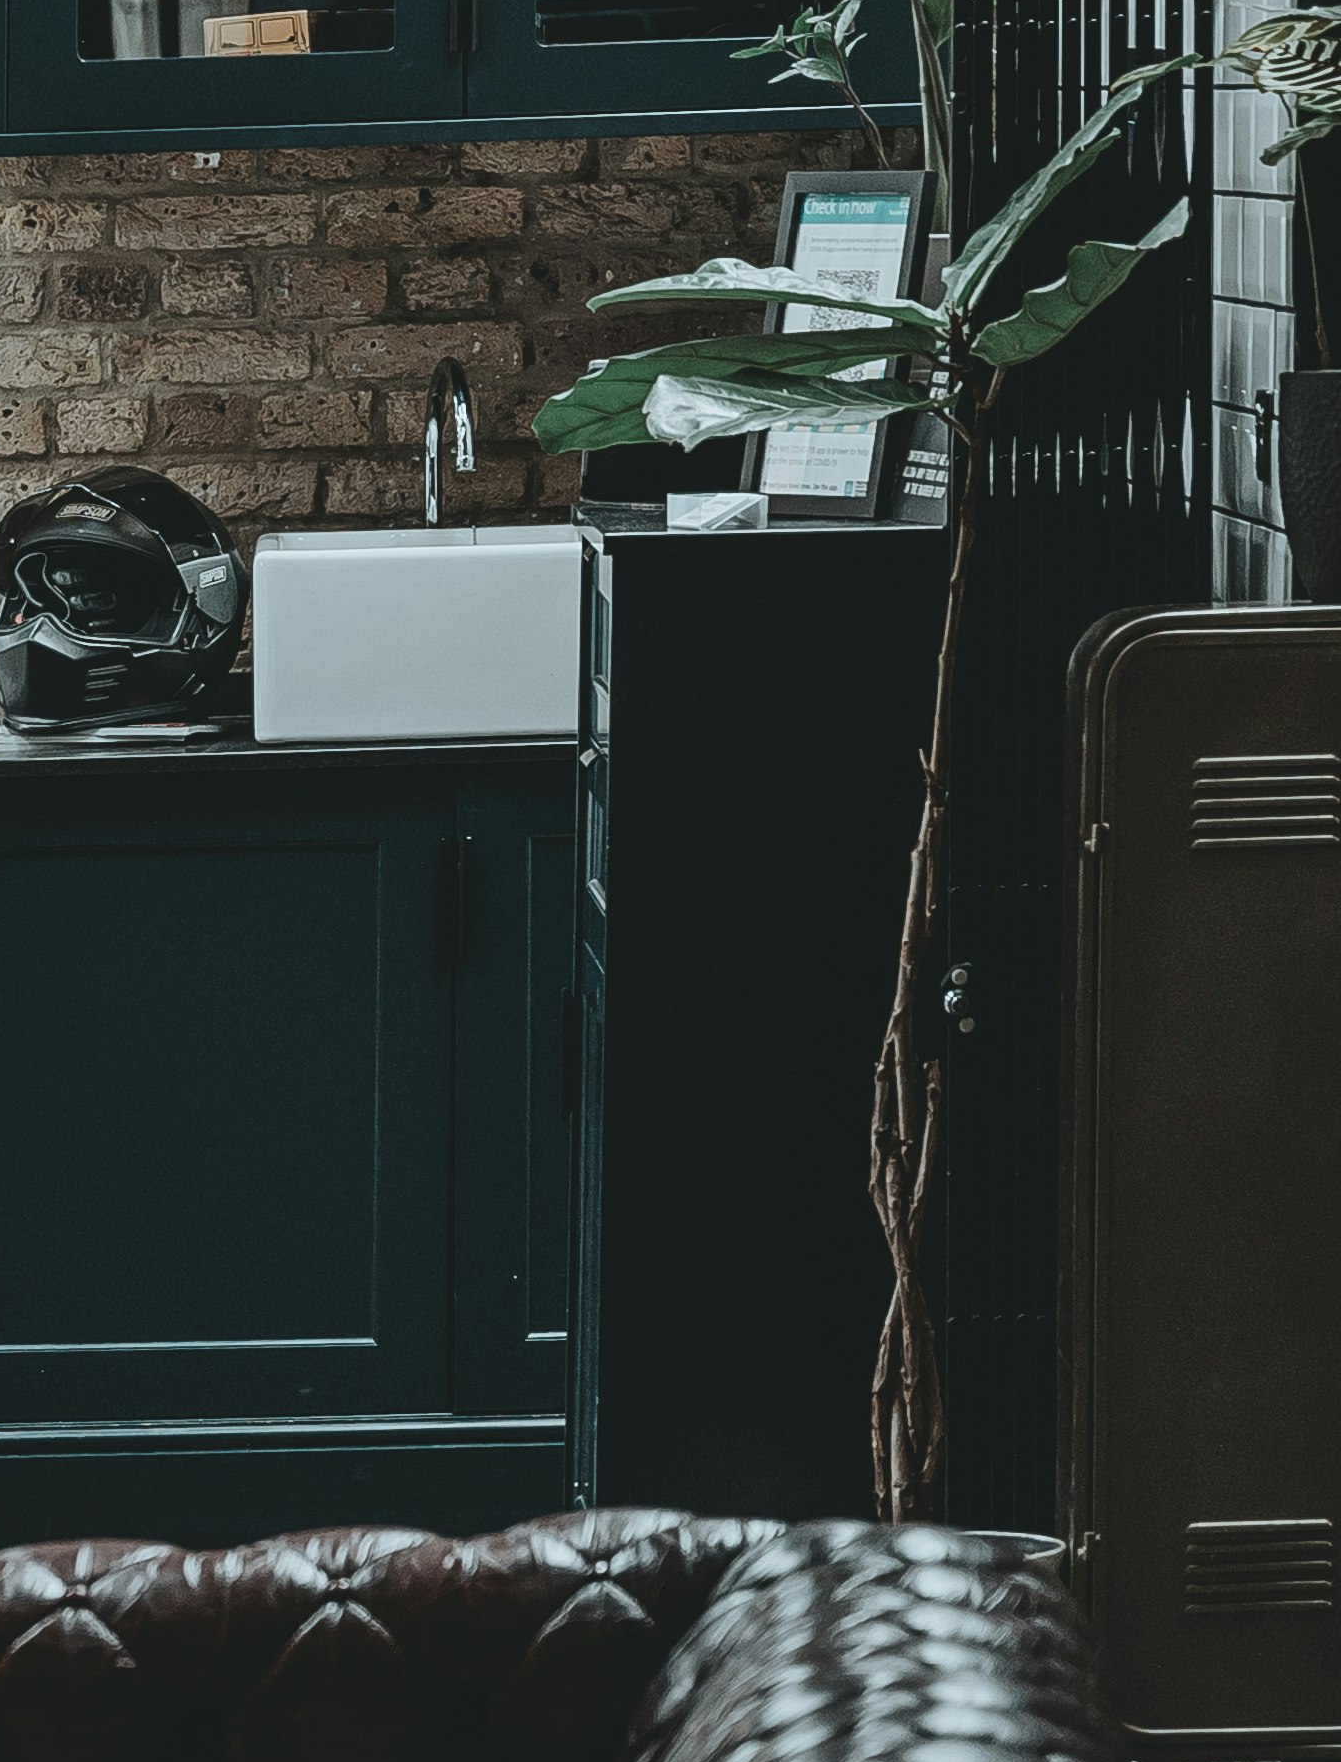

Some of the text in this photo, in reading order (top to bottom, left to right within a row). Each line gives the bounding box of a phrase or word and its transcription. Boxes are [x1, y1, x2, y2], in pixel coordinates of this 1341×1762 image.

[804, 199, 837, 215] Check
[838, 199, 850, 215] in
[851, 201, 878, 215] now
[60, 504, 111, 518] SIMPSON
